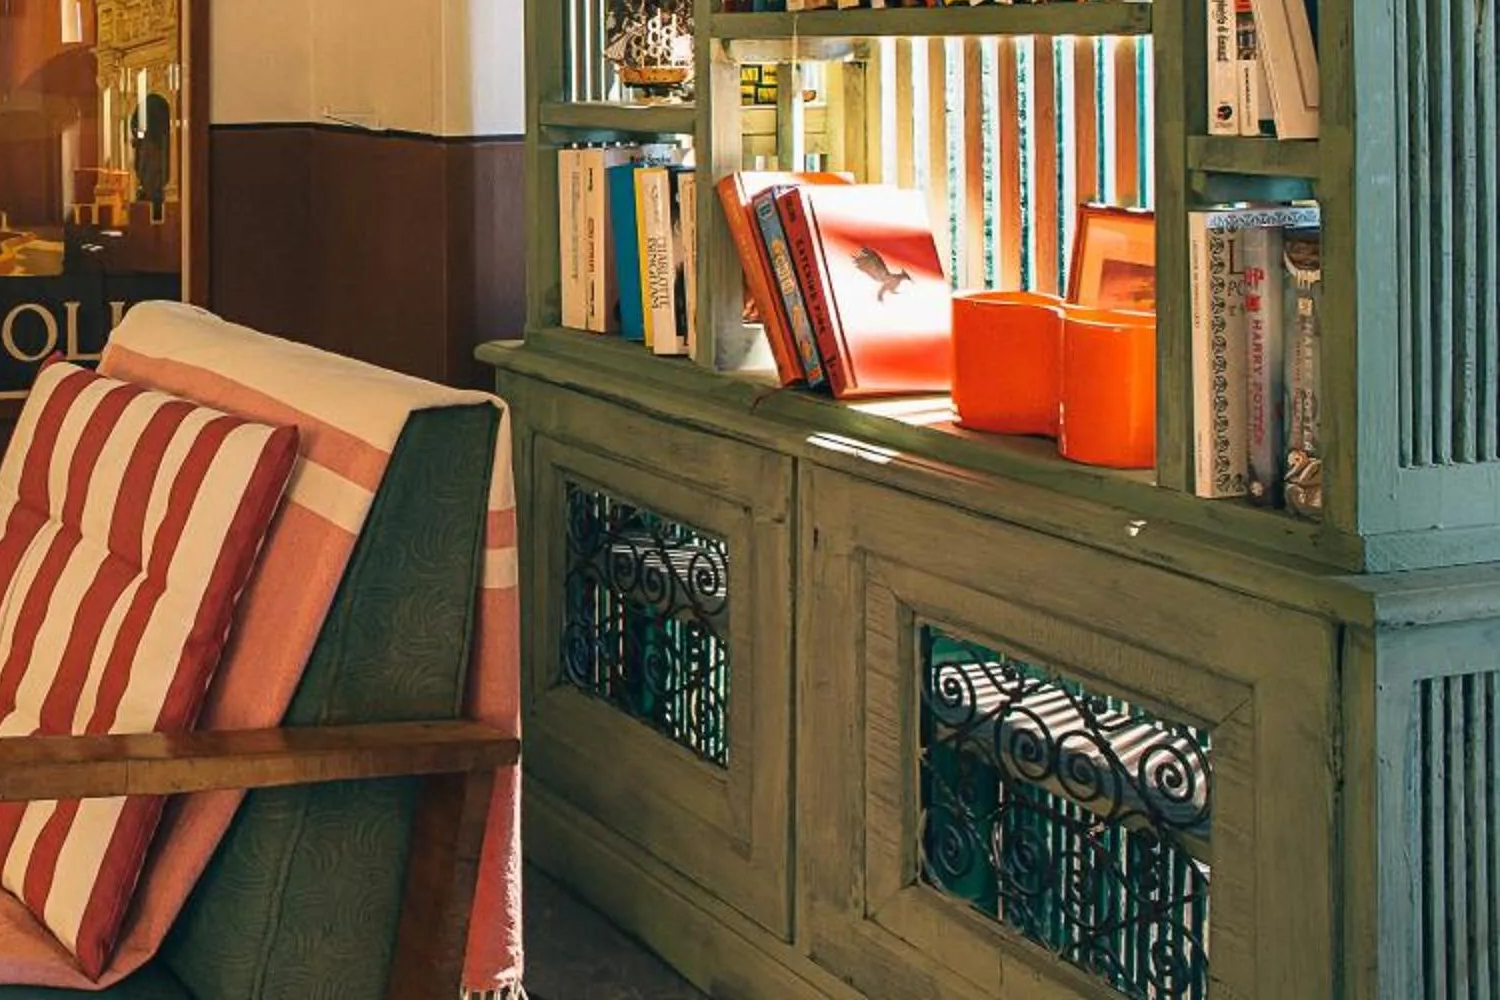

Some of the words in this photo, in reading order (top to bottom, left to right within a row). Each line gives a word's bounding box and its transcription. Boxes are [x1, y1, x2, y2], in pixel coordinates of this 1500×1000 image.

[1251, 319, 1264, 376] HARRY
[1253, 381, 1265, 446] POTTER
[1302, 388, 1316, 452] POTTER
